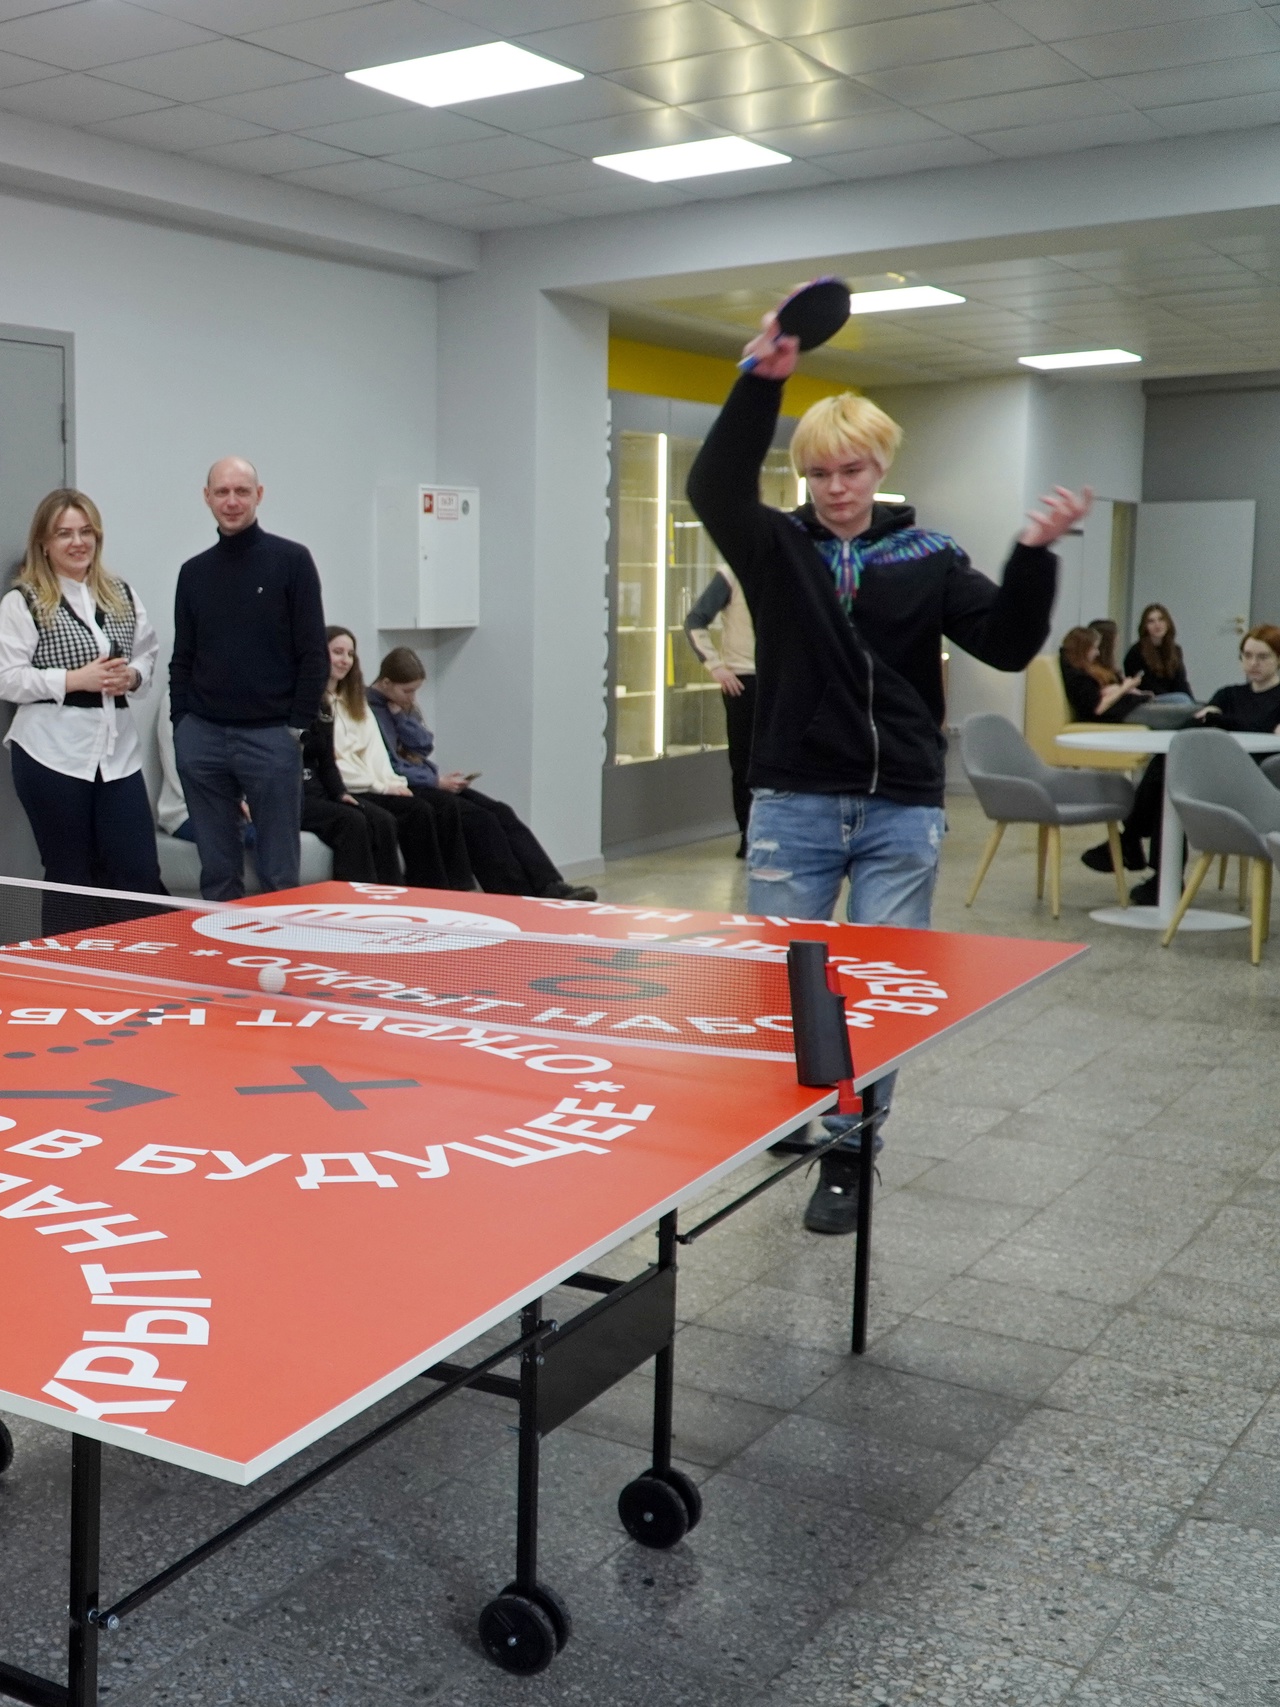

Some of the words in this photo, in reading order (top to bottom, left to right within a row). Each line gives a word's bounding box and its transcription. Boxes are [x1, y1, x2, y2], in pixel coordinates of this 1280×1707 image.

[227, 956, 525, 1014] ОТКРЫТ
[235, 1008, 613, 1075] ОТКРЫТ
[4, 1128, 104, 1160] В
[115, 1096, 657, 1189] БУДУЩЕЕ
